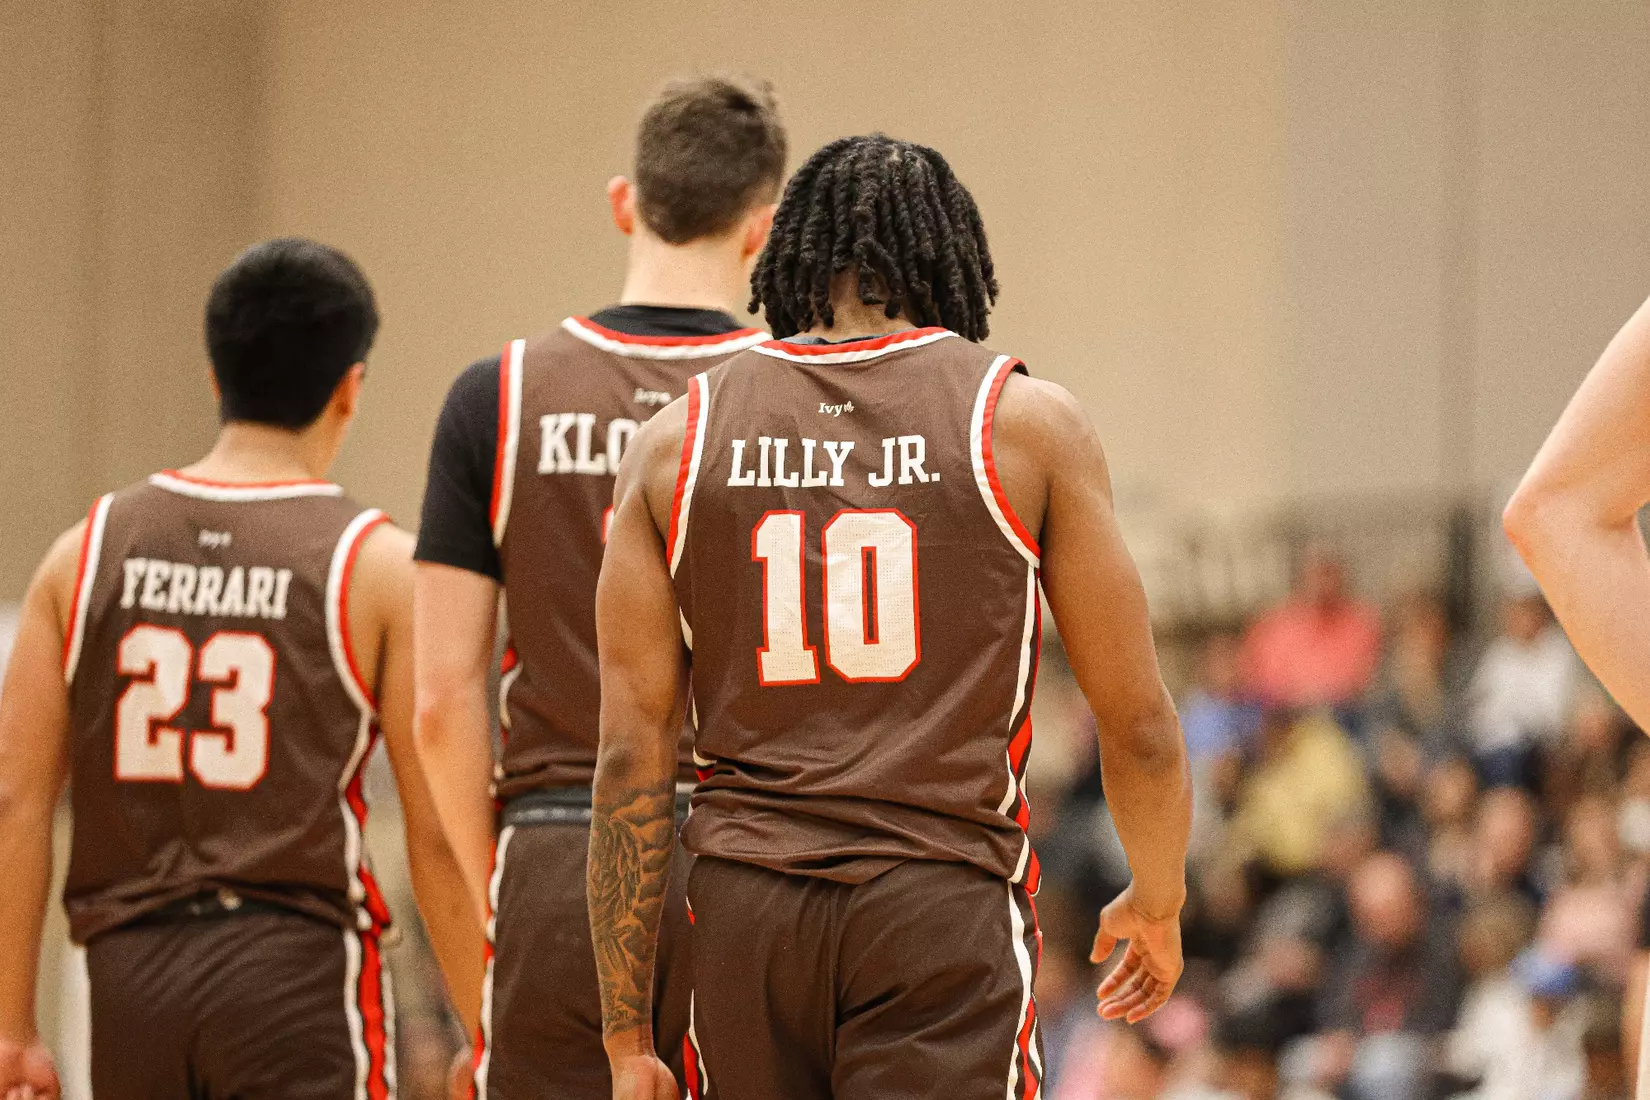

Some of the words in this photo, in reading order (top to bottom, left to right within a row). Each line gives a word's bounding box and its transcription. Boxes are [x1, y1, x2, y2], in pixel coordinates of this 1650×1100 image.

[818, 402, 843, 417] Ivy
[537, 412, 647, 475] KLO
[727, 436, 855, 488] LILLY
[868, 435, 941, 486] JR.
[120, 558, 293, 619] FERRARI
[751, 508, 922, 687] 10
[113, 622, 276, 791] 23
